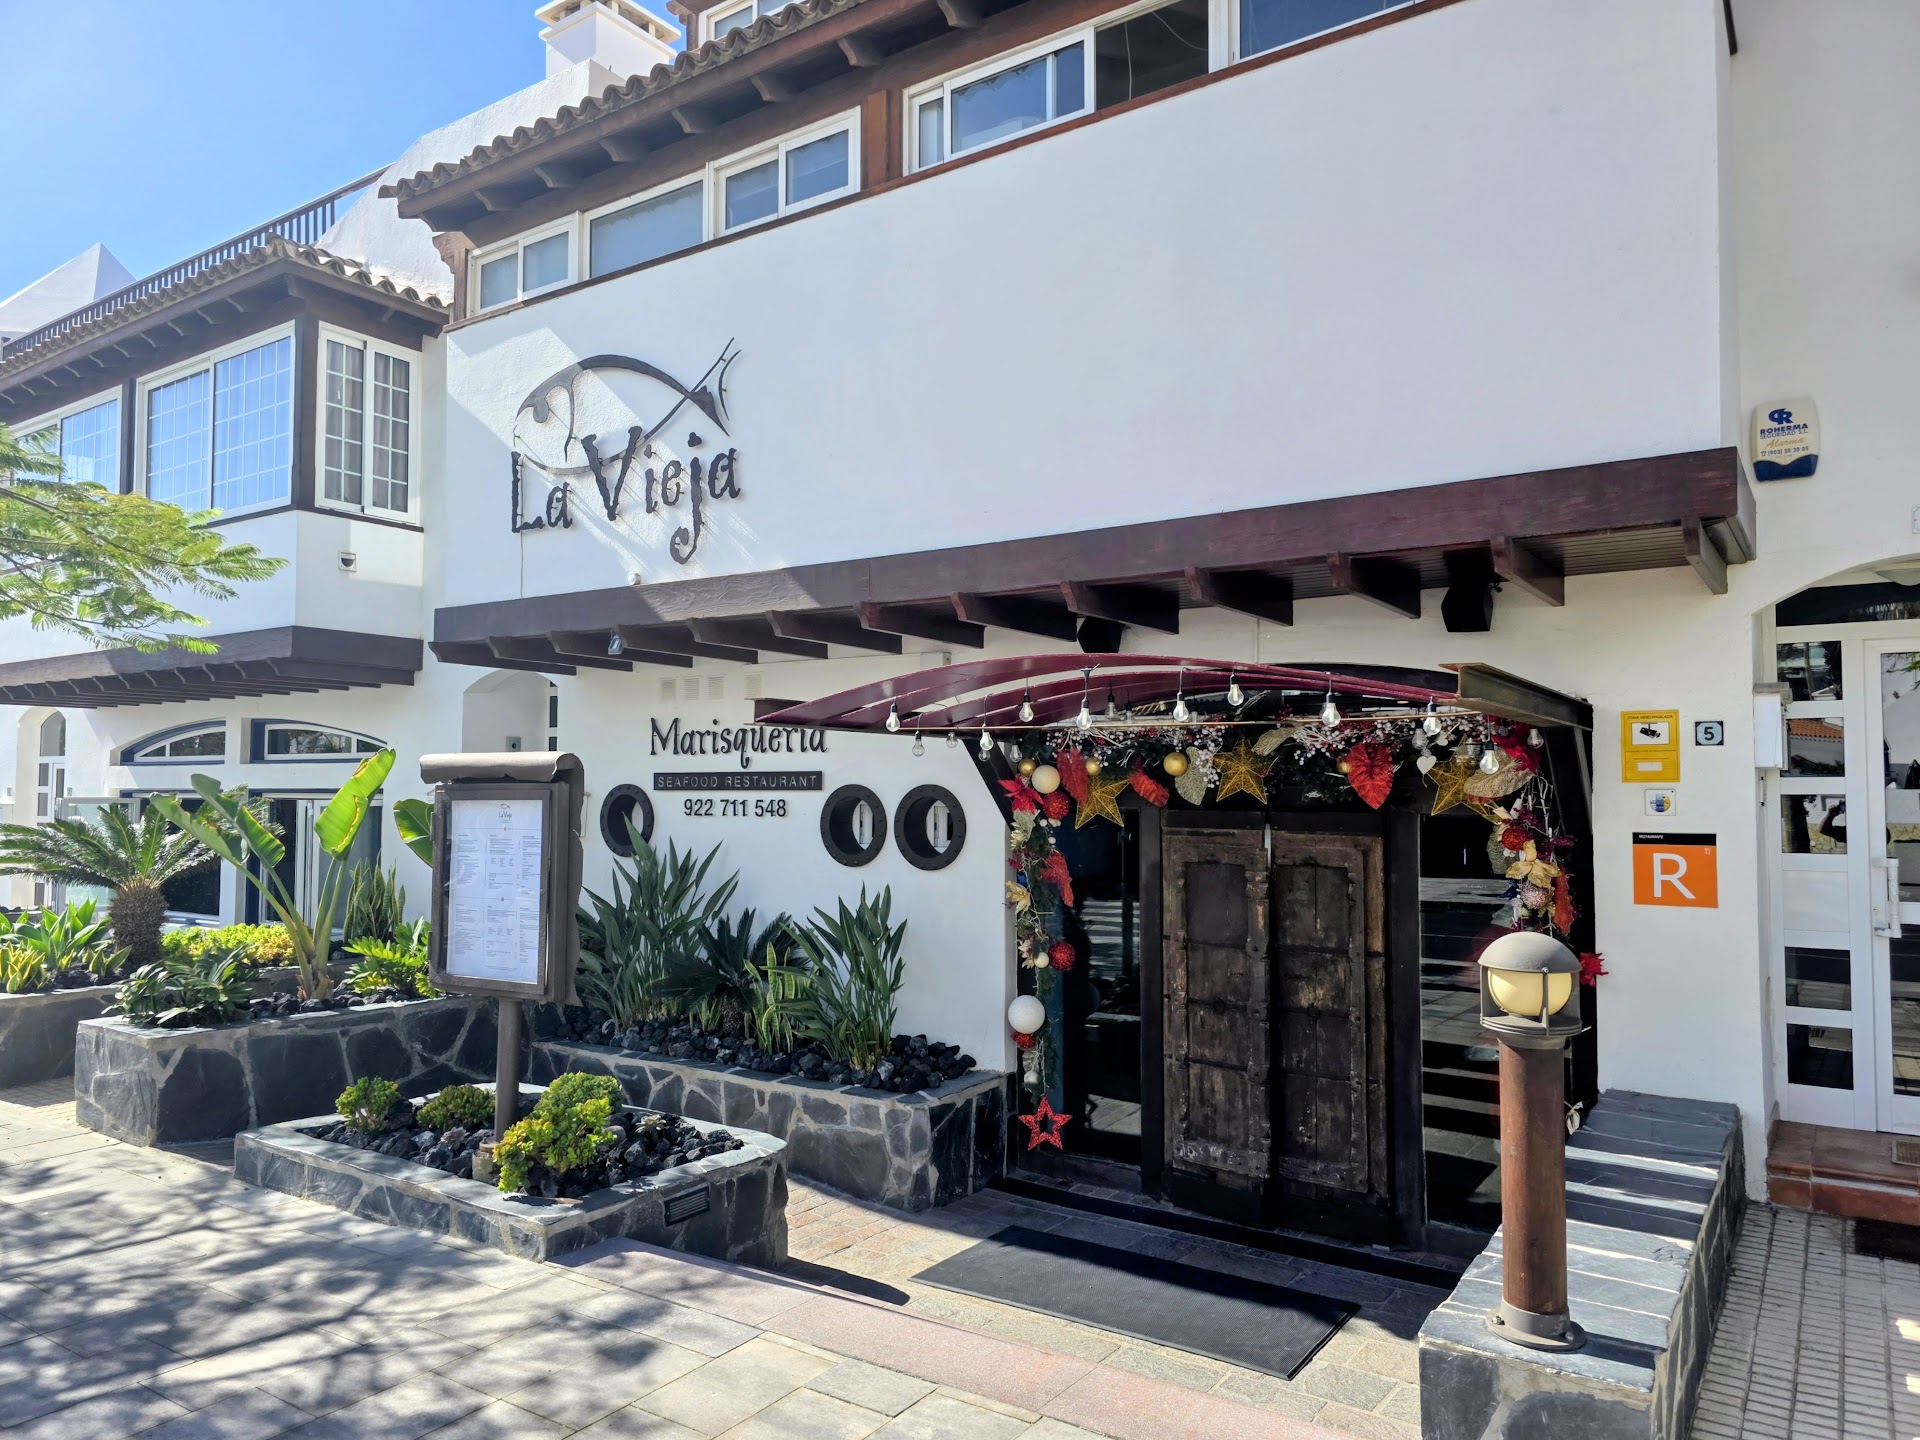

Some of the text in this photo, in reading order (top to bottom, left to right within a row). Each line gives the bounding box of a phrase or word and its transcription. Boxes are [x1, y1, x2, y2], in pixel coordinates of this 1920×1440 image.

[1760, 423, 1809, 435] ROHERMA
[1760, 431, 1796, 439] SEGURIDAD
[1764, 437, 1804, 449] Alarma
[511, 425, 741, 565] La Vieja
[1703, 726, 1715, 741] 5
[657, 775, 818, 788] SEAFOOD RESTAURANT
[684, 799, 787, 817] 922 711 548
[1653, 852, 1696, 900] R
